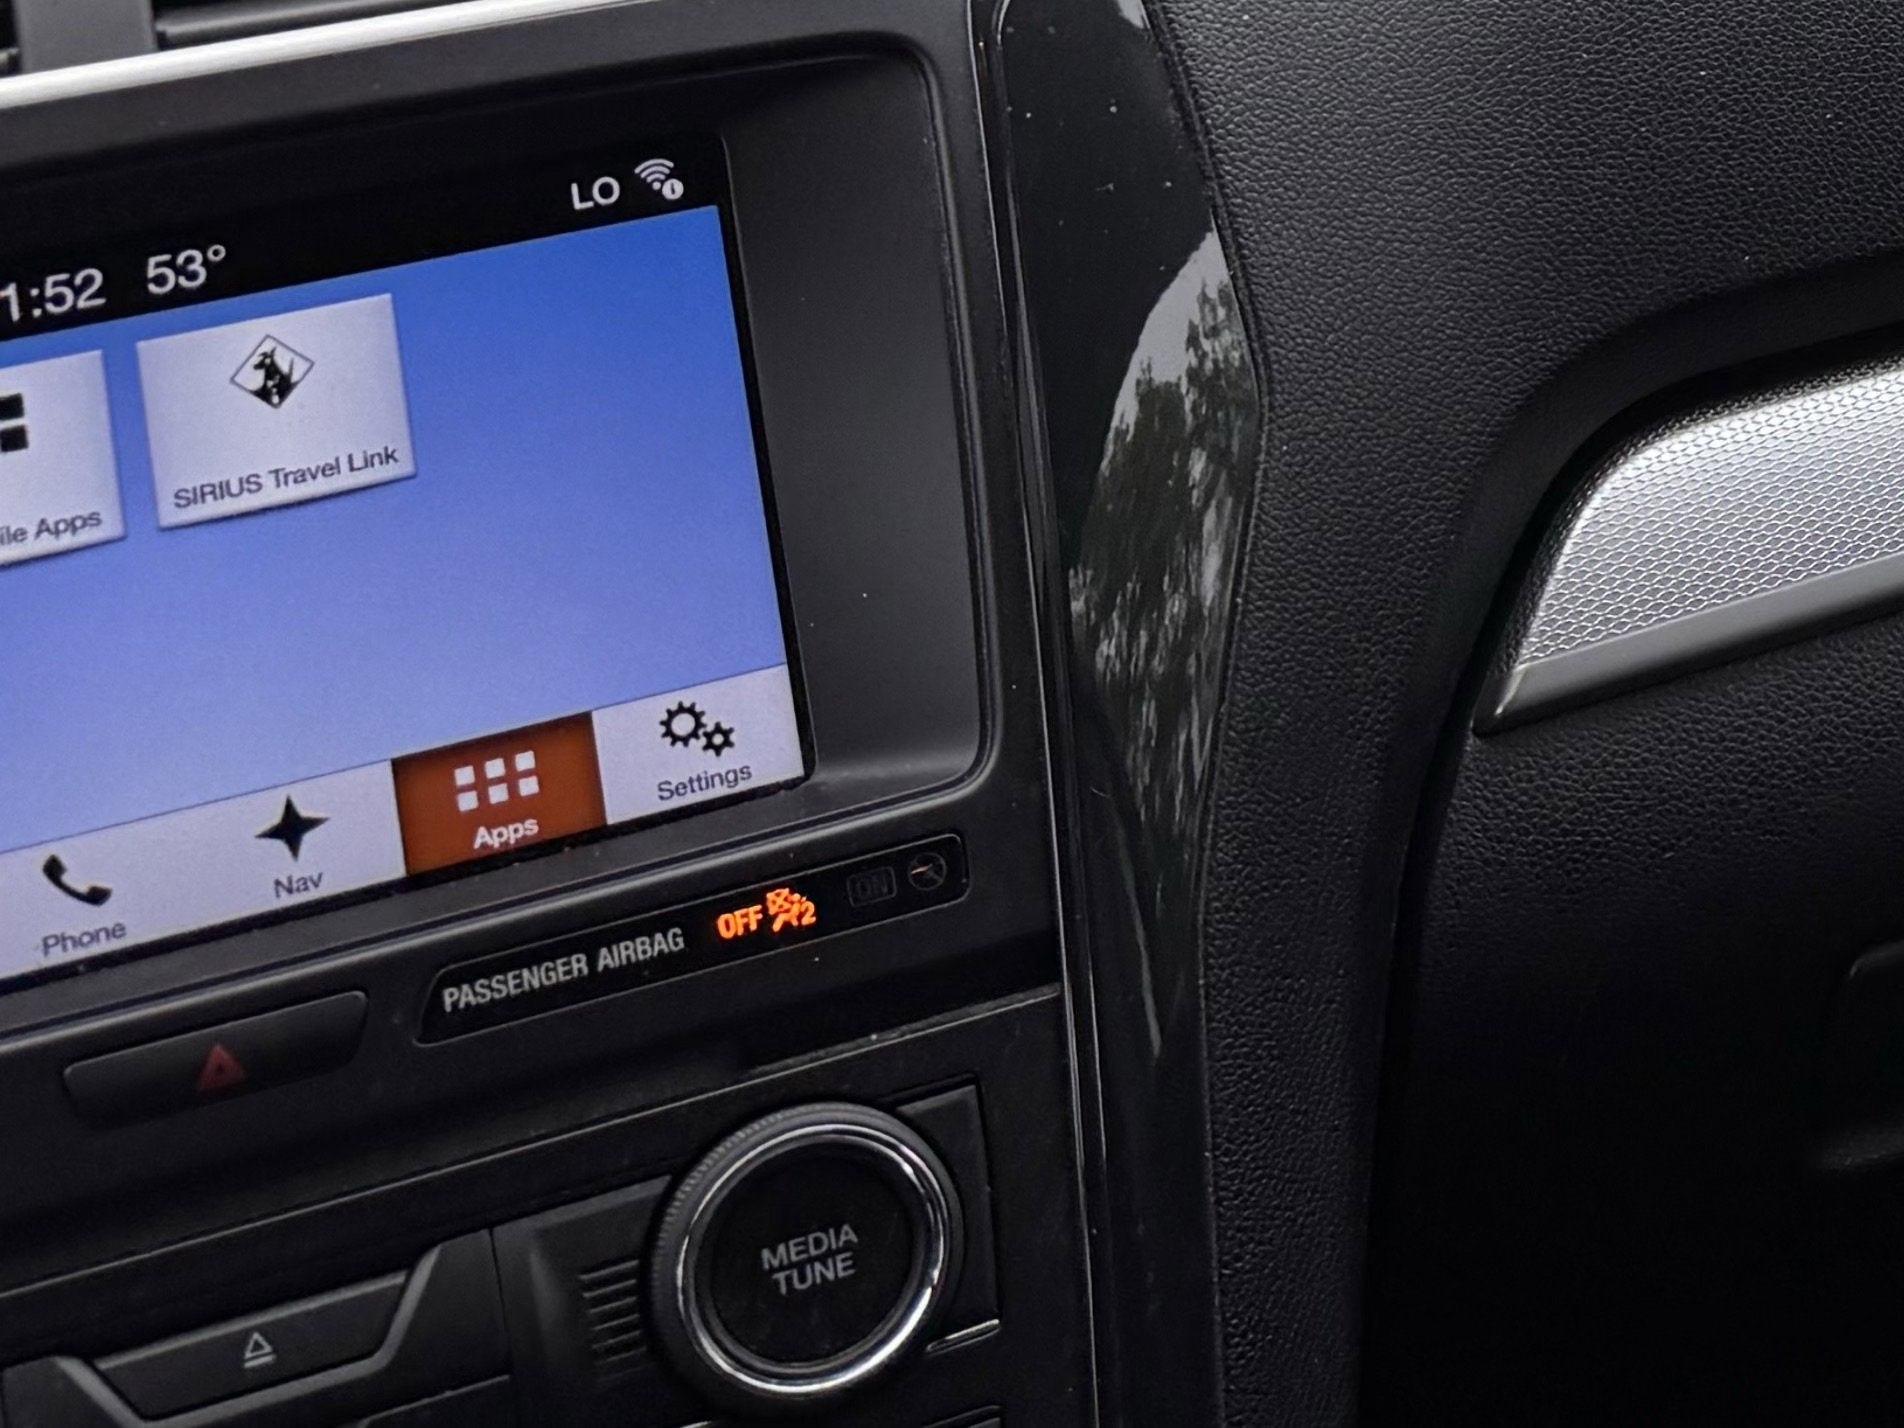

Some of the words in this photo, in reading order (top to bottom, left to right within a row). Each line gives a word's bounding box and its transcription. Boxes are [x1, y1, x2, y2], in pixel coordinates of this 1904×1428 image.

[571, 176, 621, 211] LO
[146, 244, 227, 295] 53°
[173, 473, 264, 509] SIRIUS
[268, 456, 342, 489] Travel
[347, 445, 400, 473] Link
[33, 510, 103, 541] Apps
[656, 764, 754, 802] Settings
[473, 818, 541, 850] Apps
[273, 871, 324, 899] Nav
[40, 921, 127, 958] Phone
[442, 952, 590, 1014] PASSENGER
[596, 926, 686, 973] AIRBAG
[716, 902, 764, 940] OFF
[760, 1223, 859, 1271] MEDIA
[771, 1251, 857, 1296] TUNE
